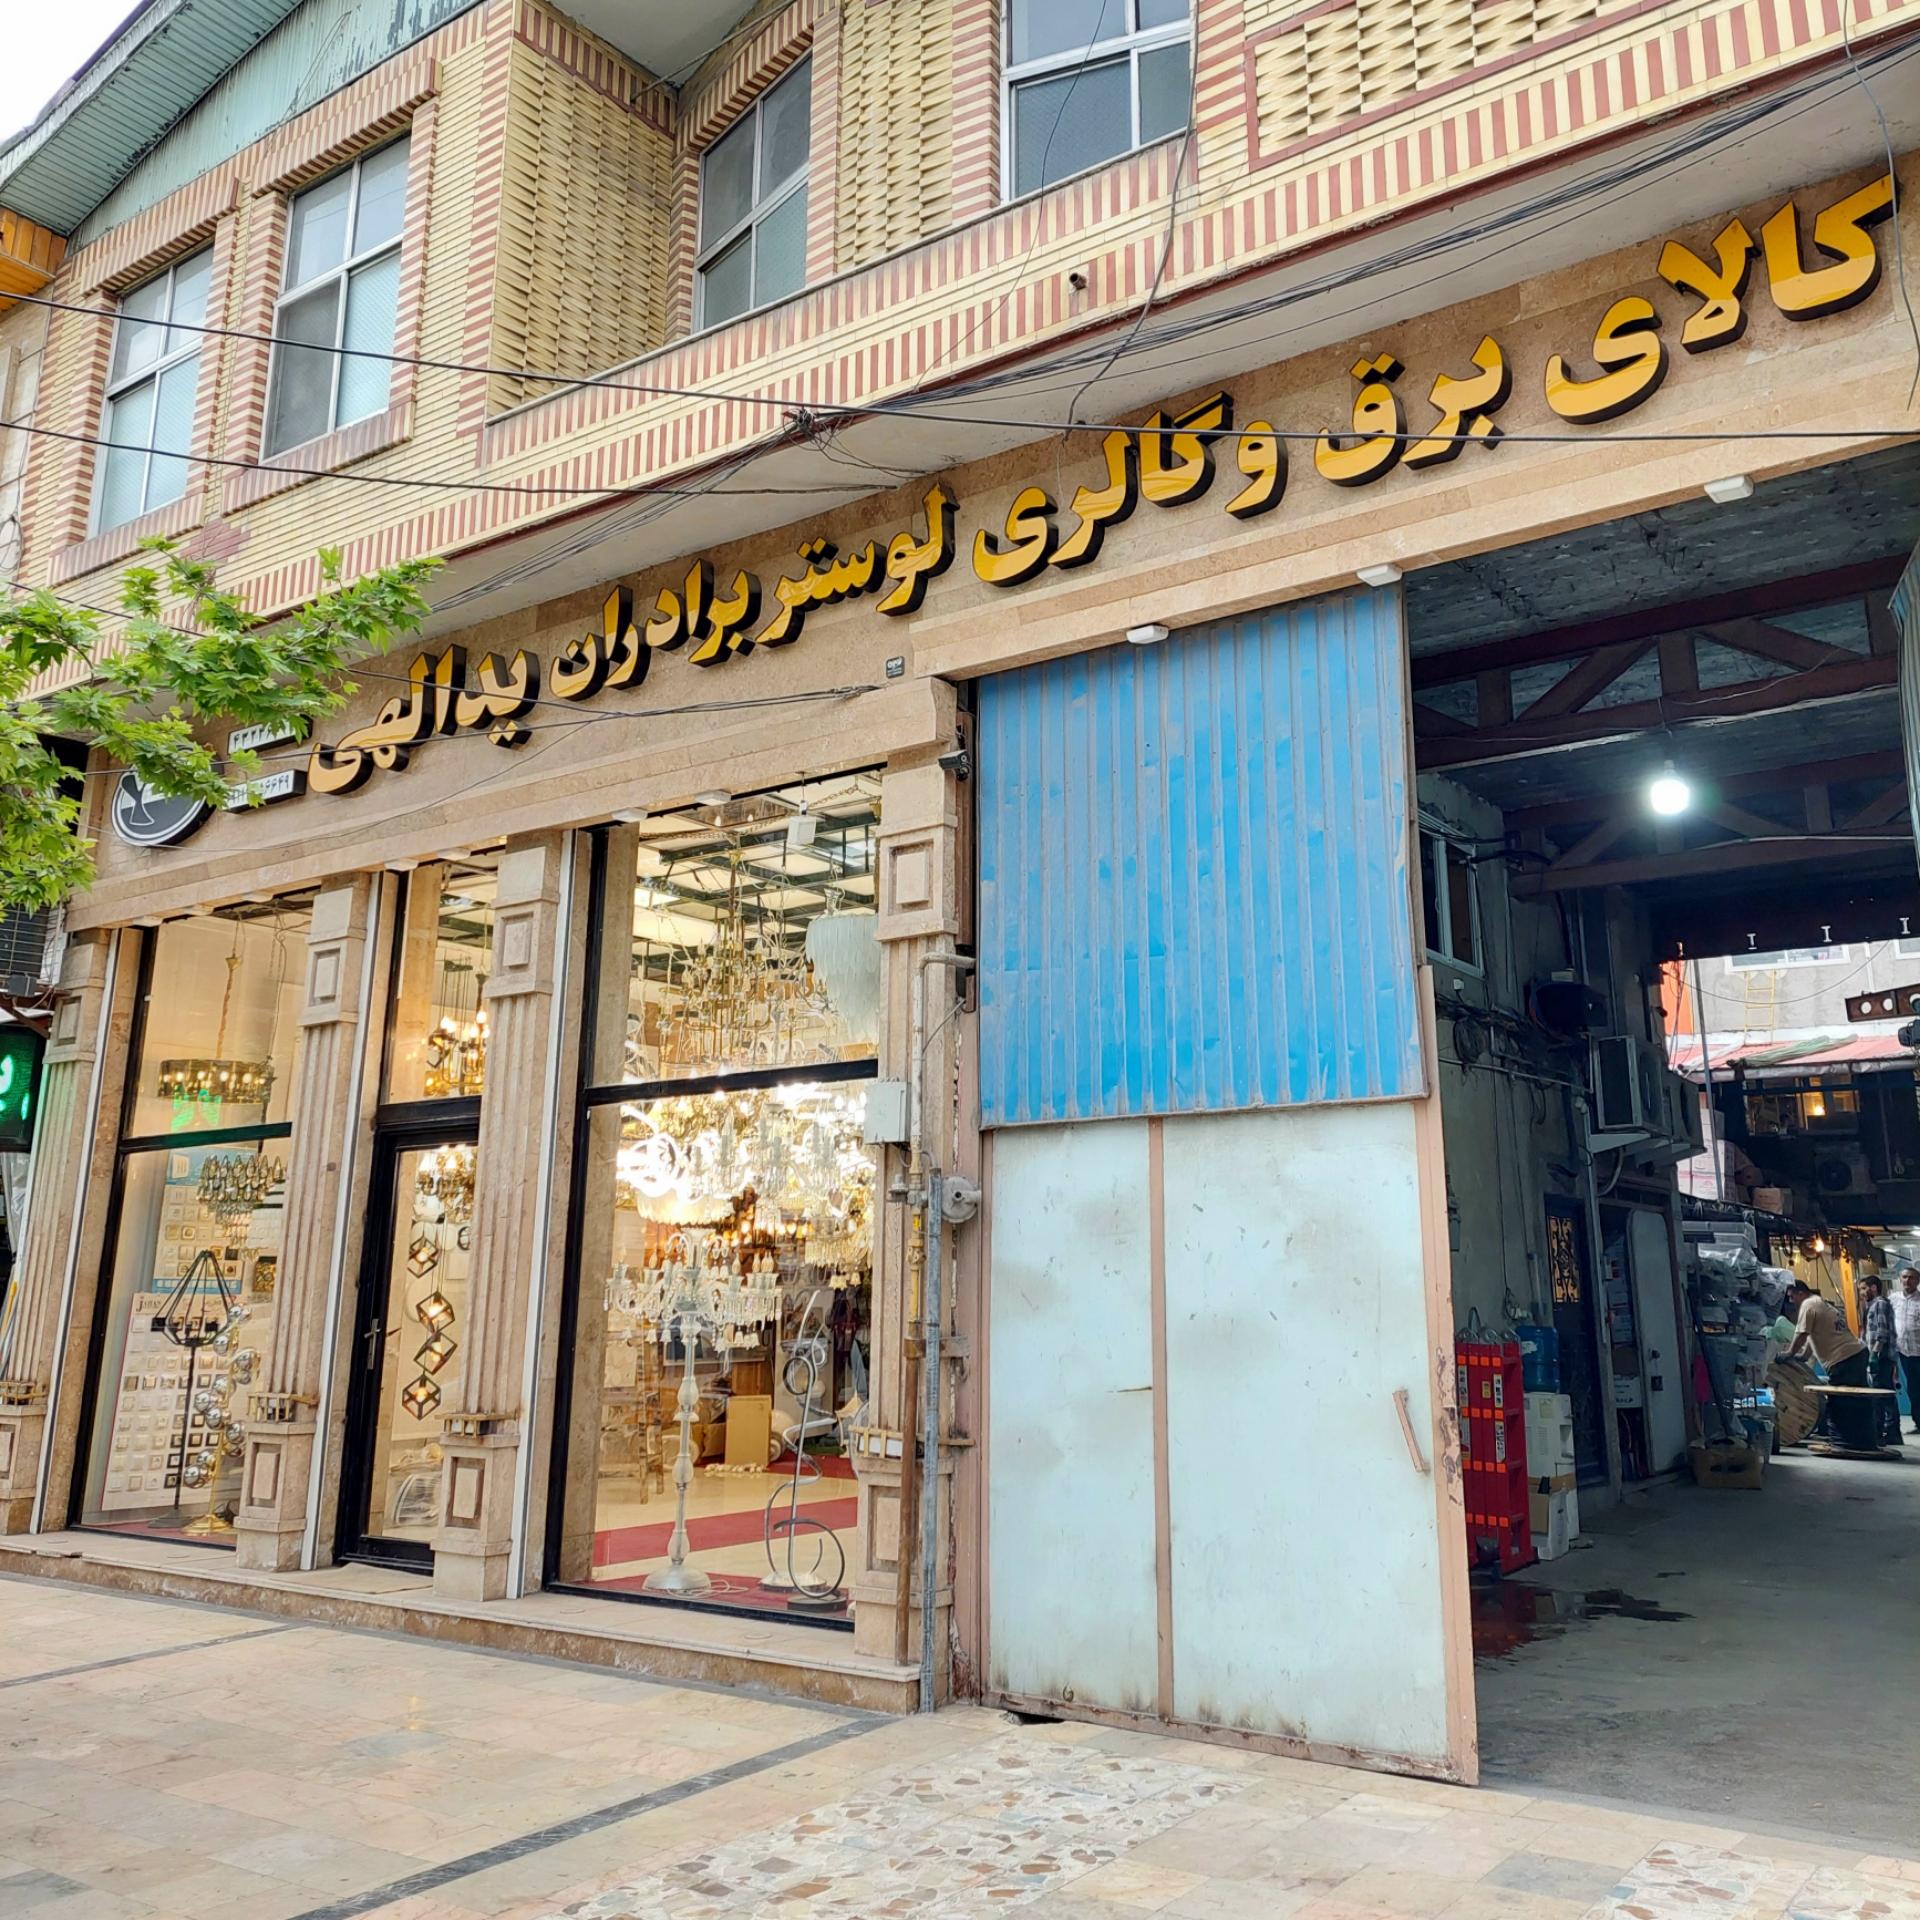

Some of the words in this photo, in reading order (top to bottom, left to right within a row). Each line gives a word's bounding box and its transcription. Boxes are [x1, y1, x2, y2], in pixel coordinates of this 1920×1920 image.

[1545, 173, 1898, 422] کالای
[1225, 420, 1288, 518] و
[1314, 335, 1511, 486] برق
[972, 391, 1233, 585] گالری
[550, 558, 760, 699] برادران
[756, 482, 959, 646] لوستر
[309, 644, 539, 794] یدالهی
